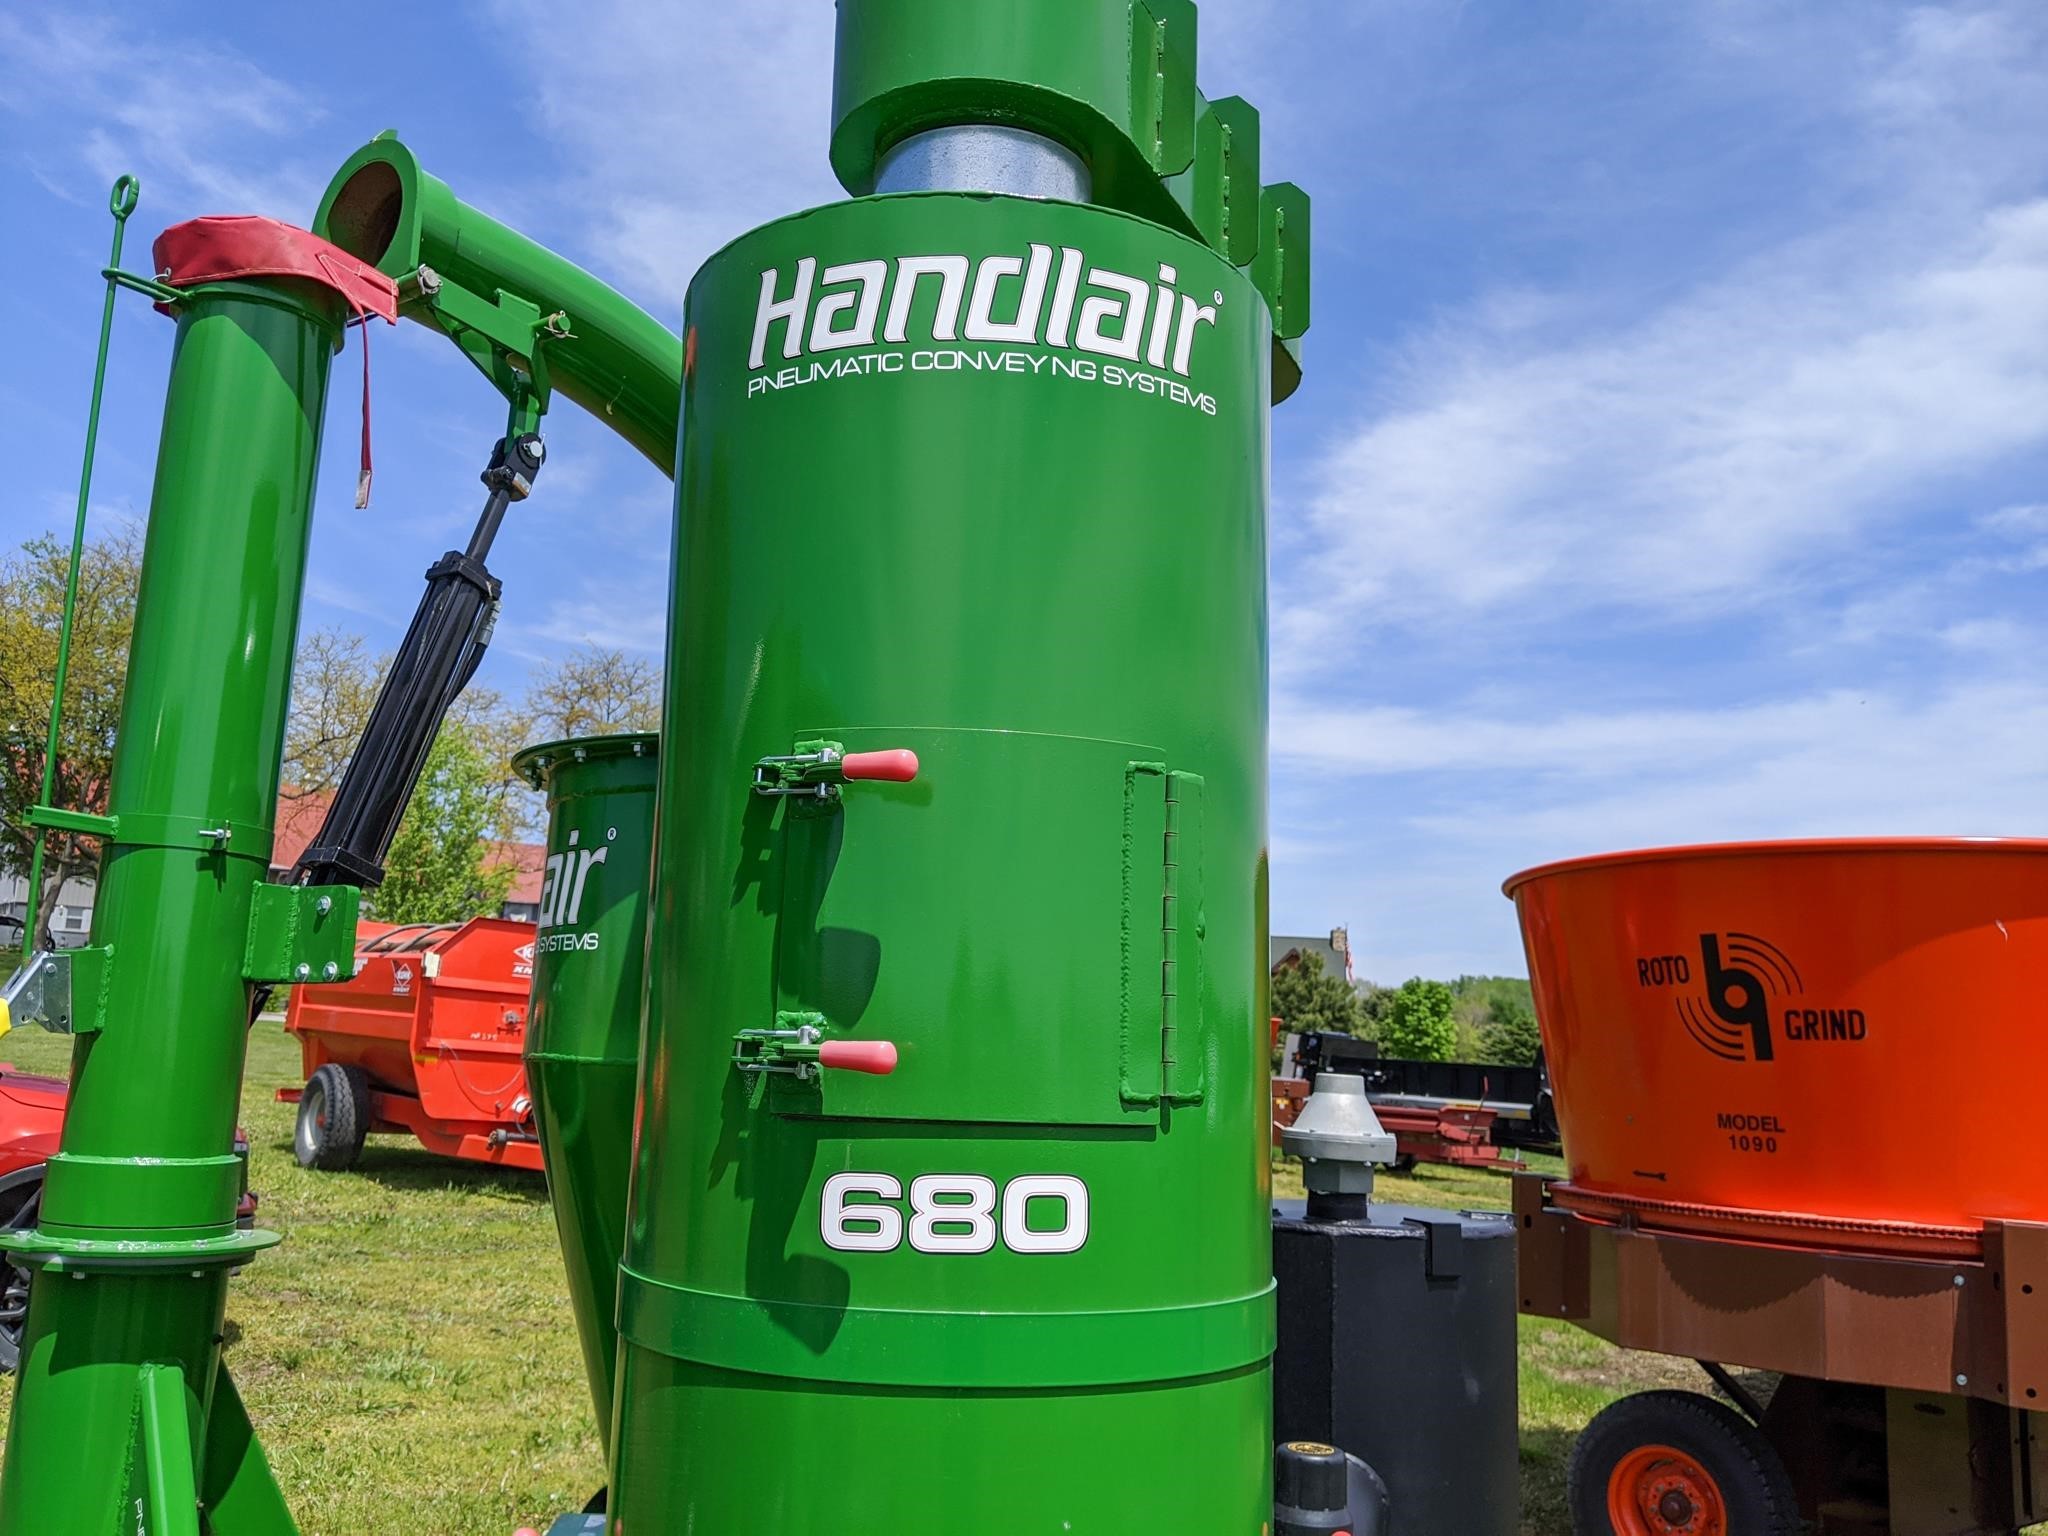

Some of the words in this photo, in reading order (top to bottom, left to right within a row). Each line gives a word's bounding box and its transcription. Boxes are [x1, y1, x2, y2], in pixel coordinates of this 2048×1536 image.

[748, 351, 904, 399] PNEUMATIC
[1103, 365, 1216, 416] SYSTEMS
[1637, 955, 1690, 987] ROTO
[1784, 1009, 1867, 1041] GRIND
[1717, 1113, 1786, 1133] MODEL
[1728, 1135, 1777, 1153] 1090
[821, 1172, 1090, 1255] 680
